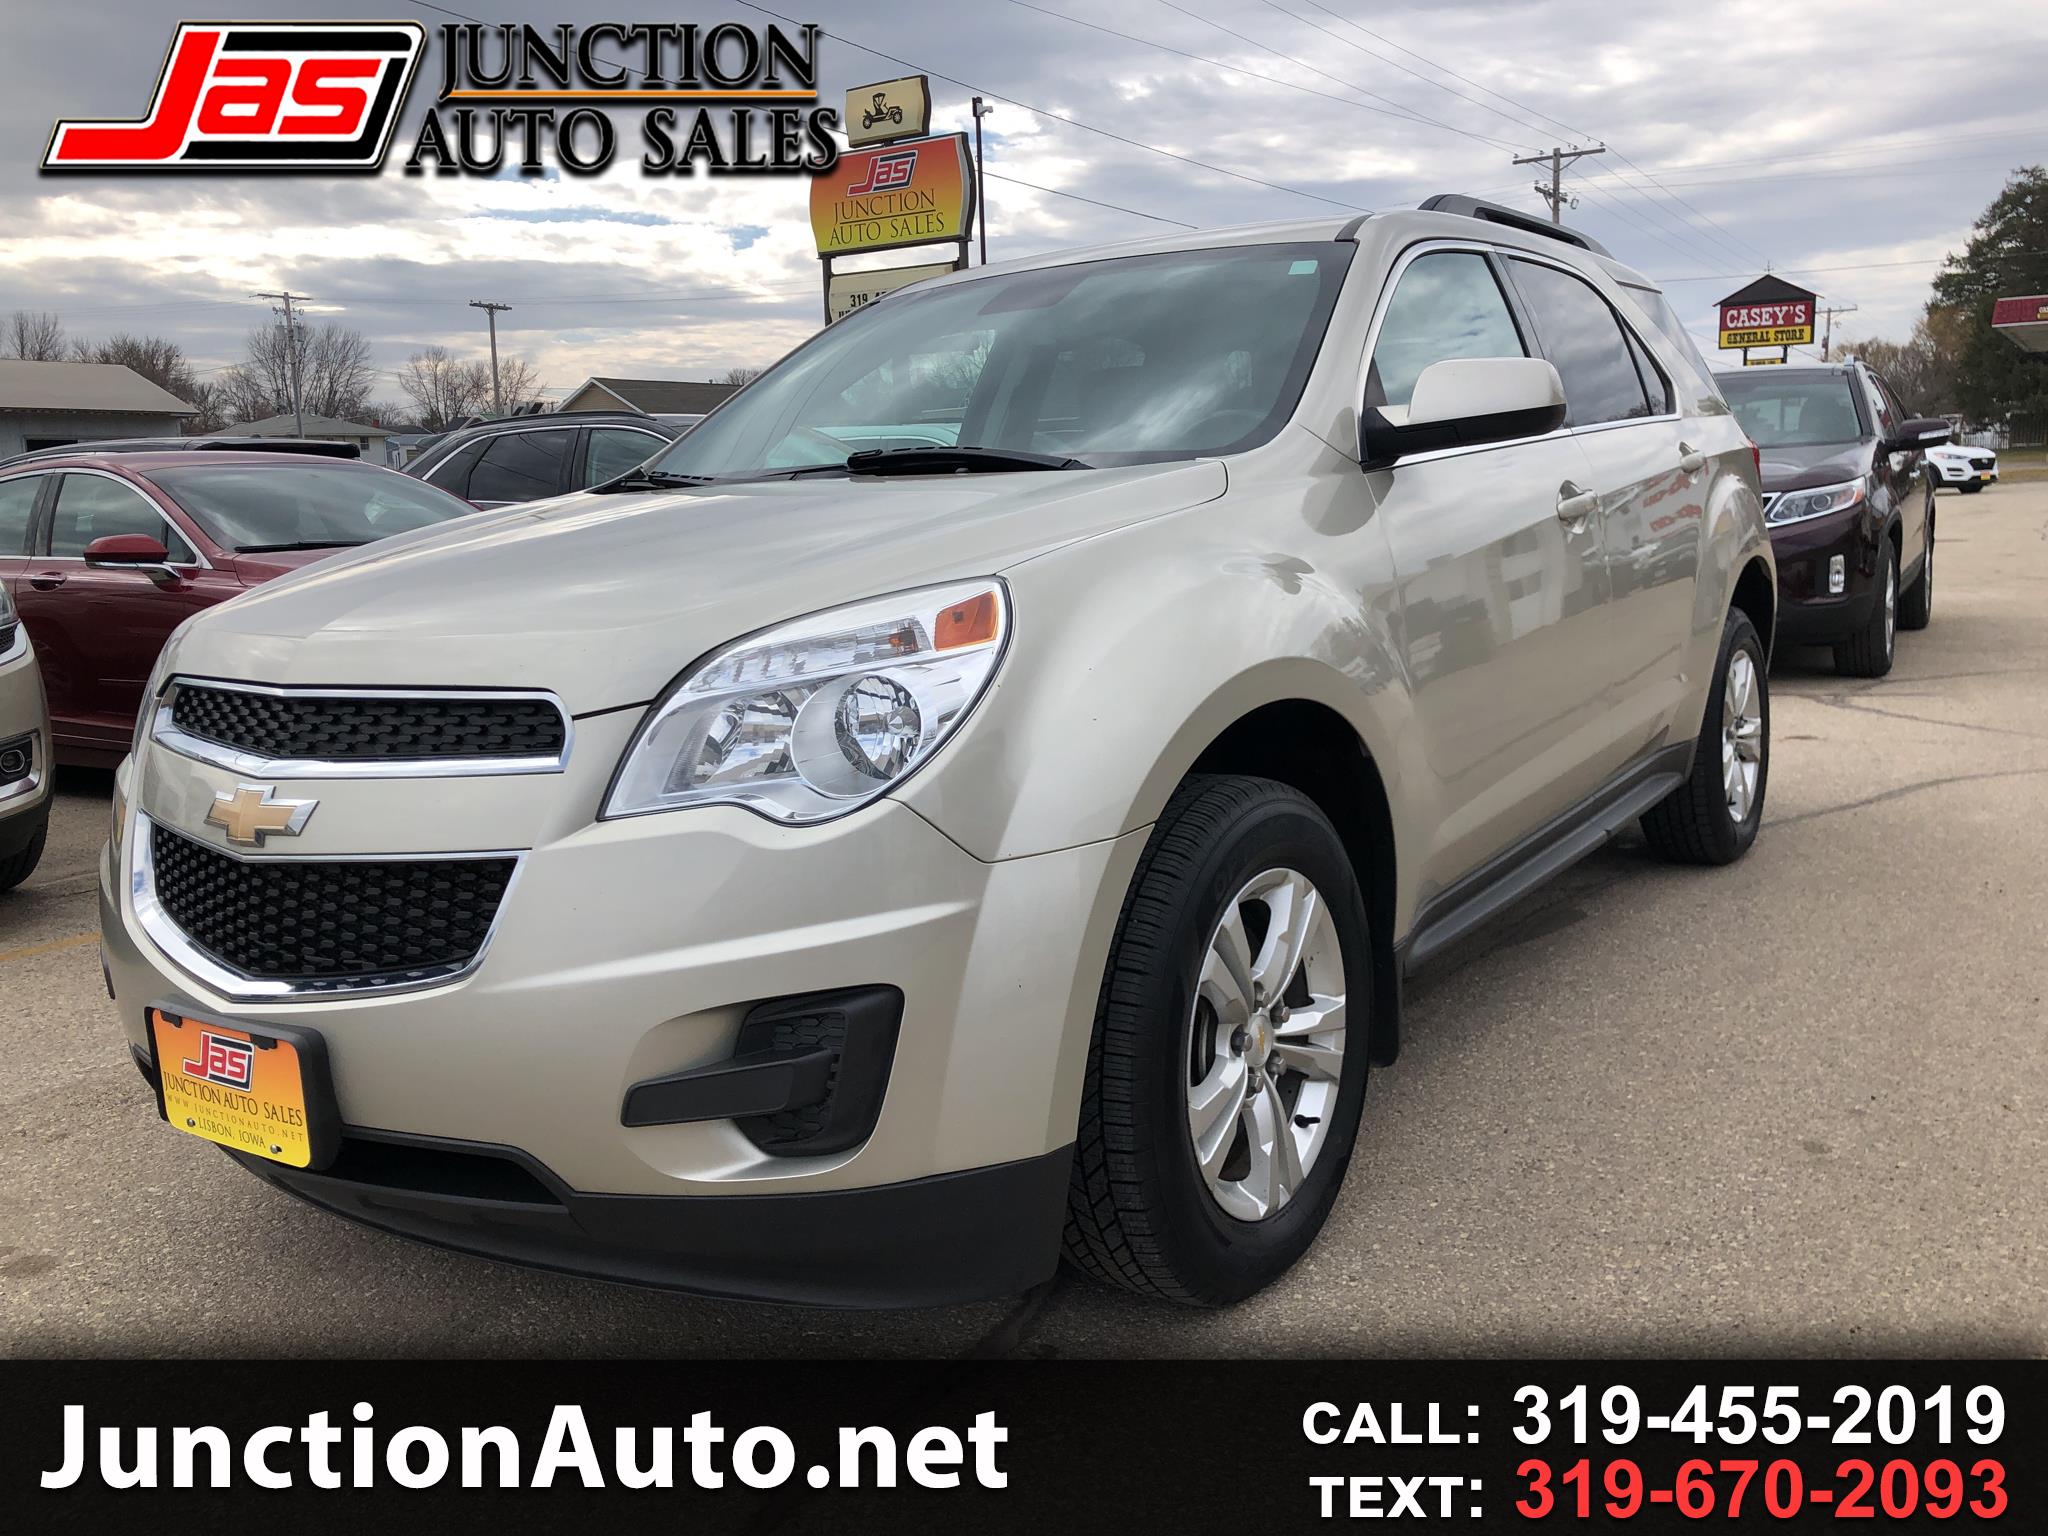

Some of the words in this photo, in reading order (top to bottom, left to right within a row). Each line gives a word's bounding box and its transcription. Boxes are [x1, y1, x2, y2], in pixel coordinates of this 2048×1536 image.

[834, 188, 936, 226] JUNCTION
[830, 222, 881, 246] AUTO
[890, 212, 945, 238] SALES
[1726, 304, 1806, 328] CASEY'S
[1726, 330, 1771, 345] GENERAL
[1773, 328, 1804, 342] STORE
[163, 1071, 221, 1105] JUNCTION
[224, 1094, 258, 1116] AUTO
[263, 1101, 303, 1127] SALES
[239, 1130, 266, 1149] IOWA
